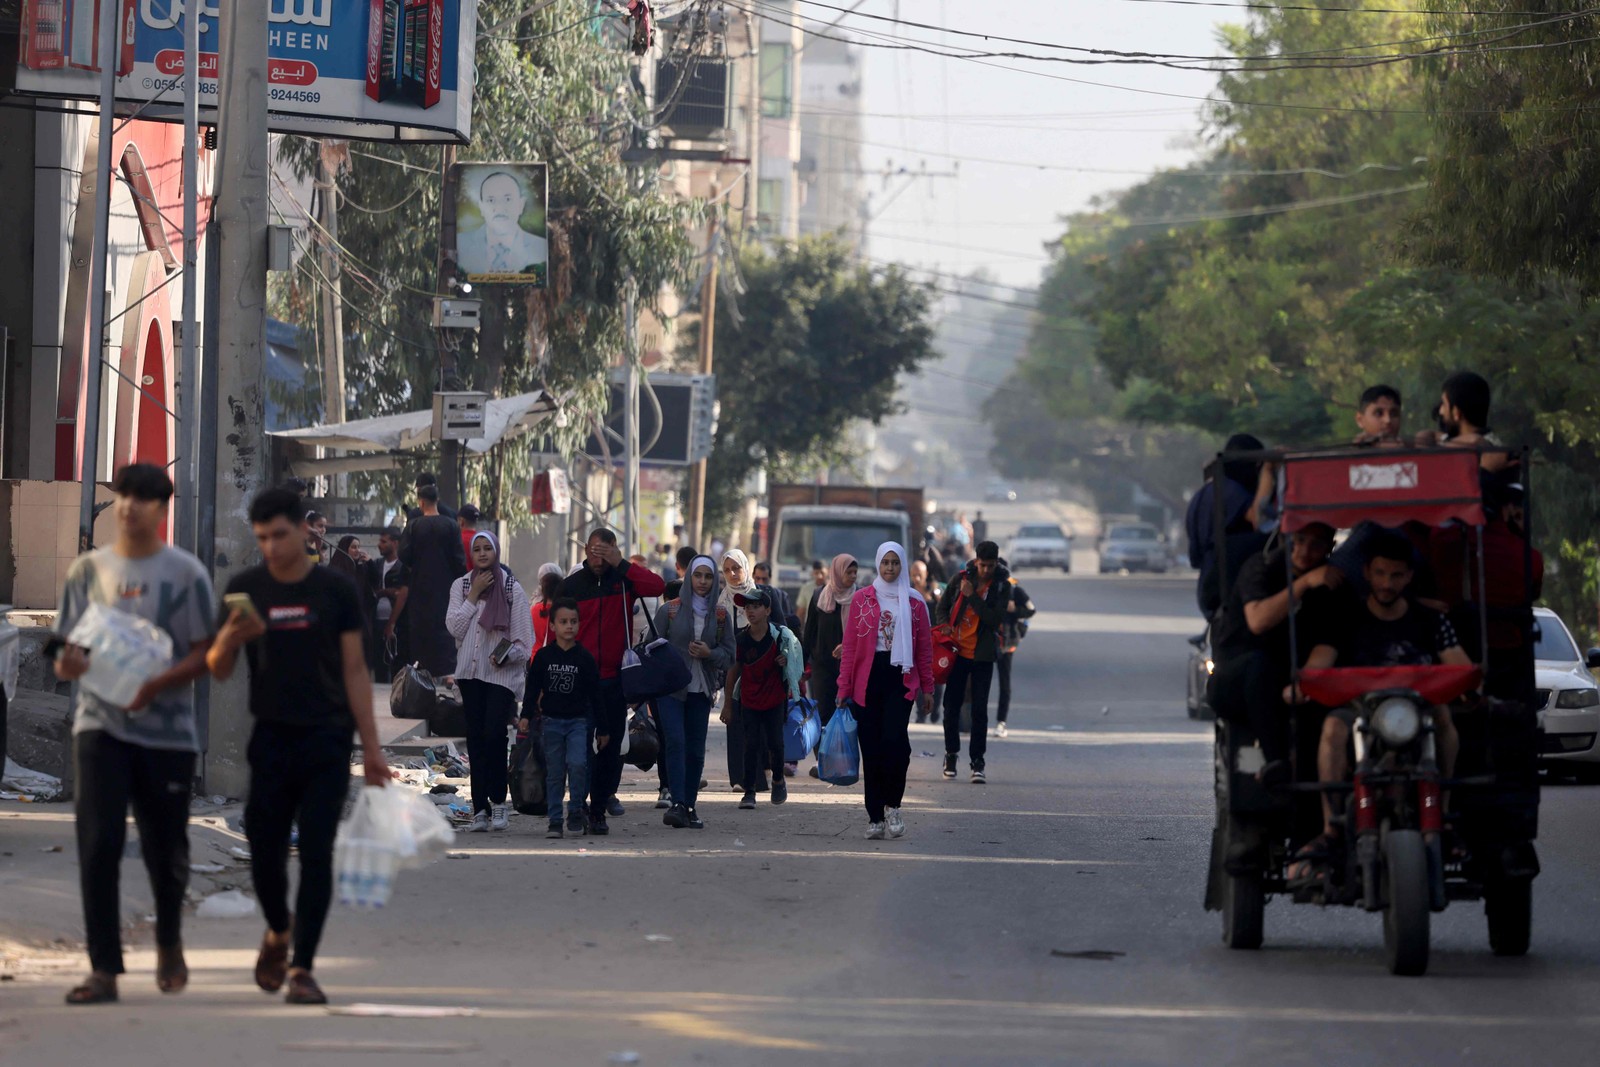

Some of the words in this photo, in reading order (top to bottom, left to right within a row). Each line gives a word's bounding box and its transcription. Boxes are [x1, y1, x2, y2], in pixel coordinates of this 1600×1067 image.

[269, 30, 329, 51] HEEN
[271, 65, 305, 81] لبيع
[268, 89, 321, 103] -9244569
[547, 664, 579, 673] ATLANTA
[549, 671, 575, 694] 73
